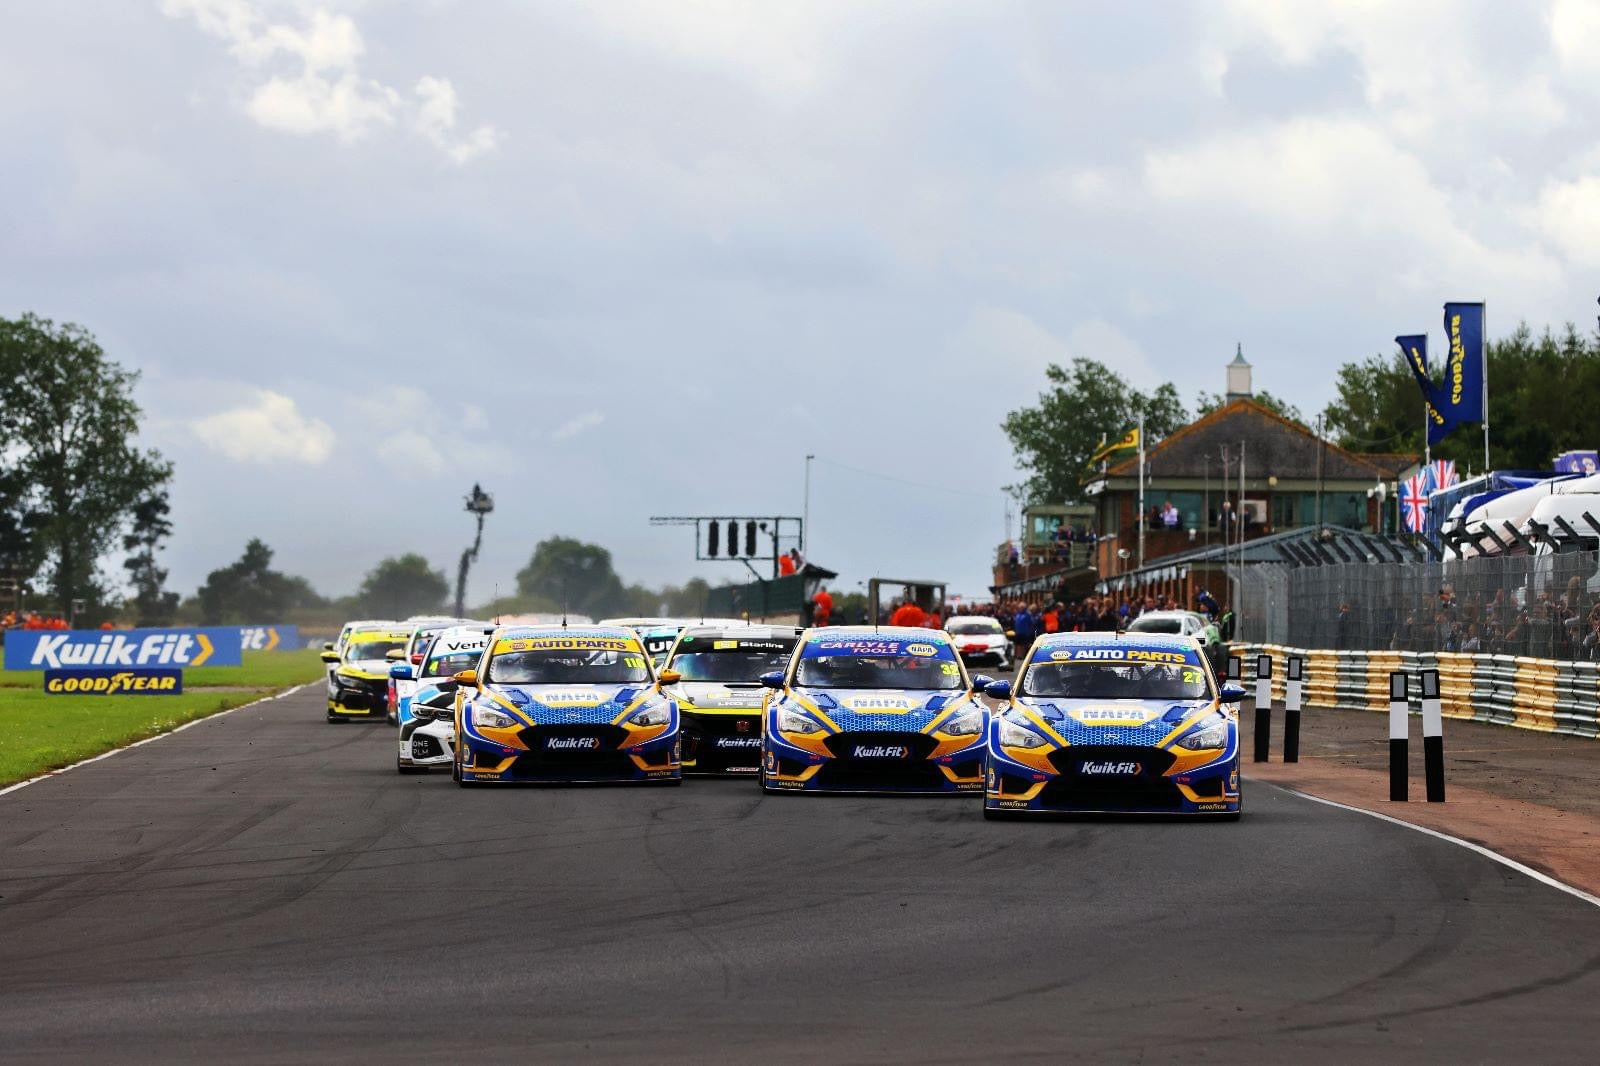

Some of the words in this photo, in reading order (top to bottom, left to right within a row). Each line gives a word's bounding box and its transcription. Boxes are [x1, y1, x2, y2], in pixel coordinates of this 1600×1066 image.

[240, 627, 264, 650] it
[531, 640, 574, 649] AUTO
[576, 640, 627, 650] PARTS
[911, 646, 933, 654] NAPA
[1075, 650, 1124, 659] AUTO
[1127, 650, 1186, 663] PARTS
[1183, 671, 1201, 684] 27
[48, 673, 176, 695] GOODYEAR
[854, 698, 909, 708] NAPA
[1083, 709, 1145, 719] NAPA
